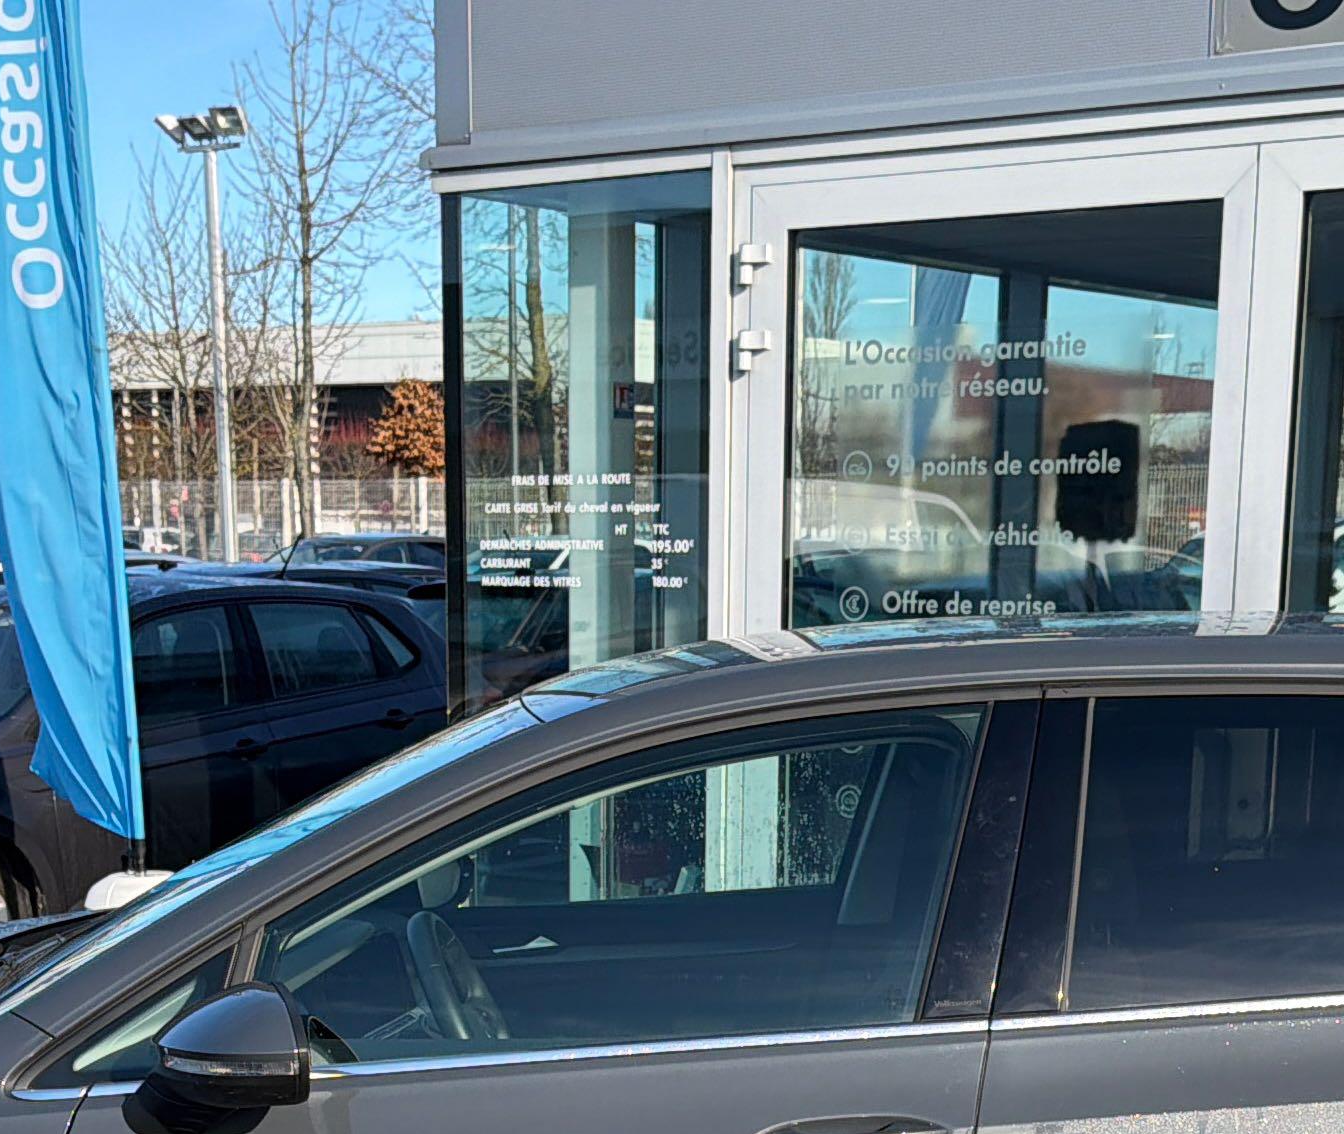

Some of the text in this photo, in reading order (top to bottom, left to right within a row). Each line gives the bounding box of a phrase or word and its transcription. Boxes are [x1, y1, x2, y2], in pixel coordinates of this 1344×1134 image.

[844, 332, 1087, 367] L'Occasion garantie
[844, 371, 1049, 407] par notre réseau.
[922, 454, 987, 481] points
[994, 451, 1023, 476] de
[1029, 448, 1122, 475] contrôle
[512, 473, 631, 486] FRAIS DE MISE A LA ROUTE
[485, 503, 511, 514] CARTE
[514, 503, 538, 514] GRISE
[564, 502, 575, 513] du
[579, 502, 607, 513] cheval
[611, 504, 623, 513] en
[626, 502, 660, 515] vigueur
[615, 523, 669, 535] HT TTC
[480, 557, 531, 569] CARBURANT
[481, 575, 531, 587] MARQUAGE
[533, 575, 550, 587] DES
[553, 575, 581, 587] VITRES
[882, 590, 1056, 616] Offre de reprise
